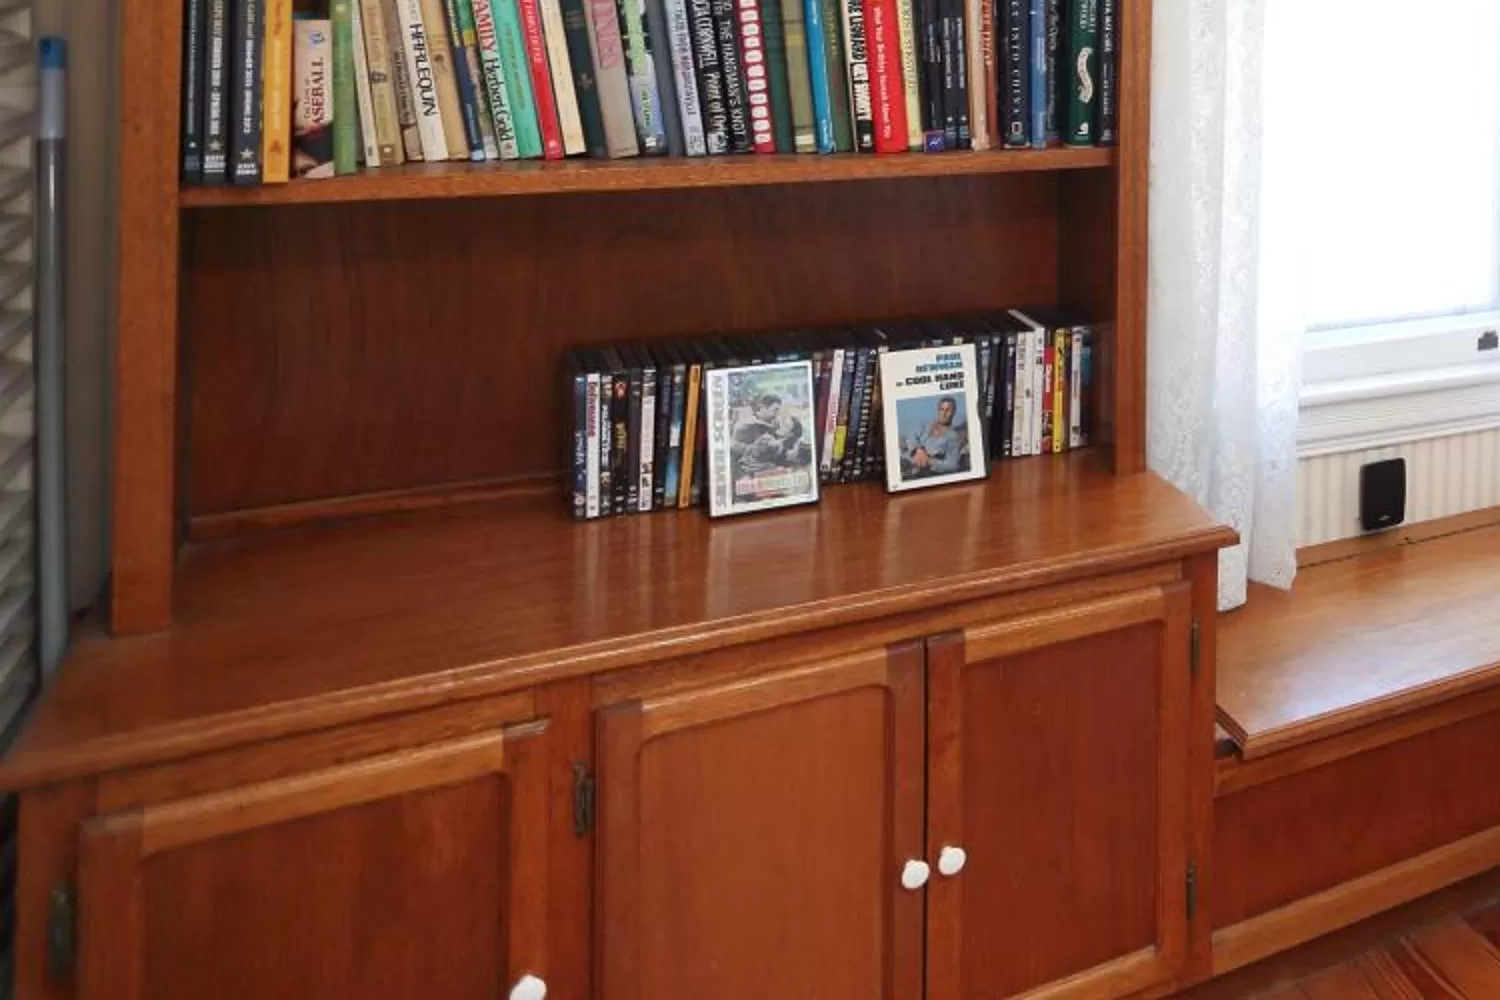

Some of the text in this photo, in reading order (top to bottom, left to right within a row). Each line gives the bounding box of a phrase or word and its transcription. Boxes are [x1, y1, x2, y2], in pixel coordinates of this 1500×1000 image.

[409, 23, 438, 117] HARLEQUIN
[311, 57, 324, 124] ASEBALL
[905, 375, 932, 386] COOL
[915, 361, 963, 373] NEWMAN
